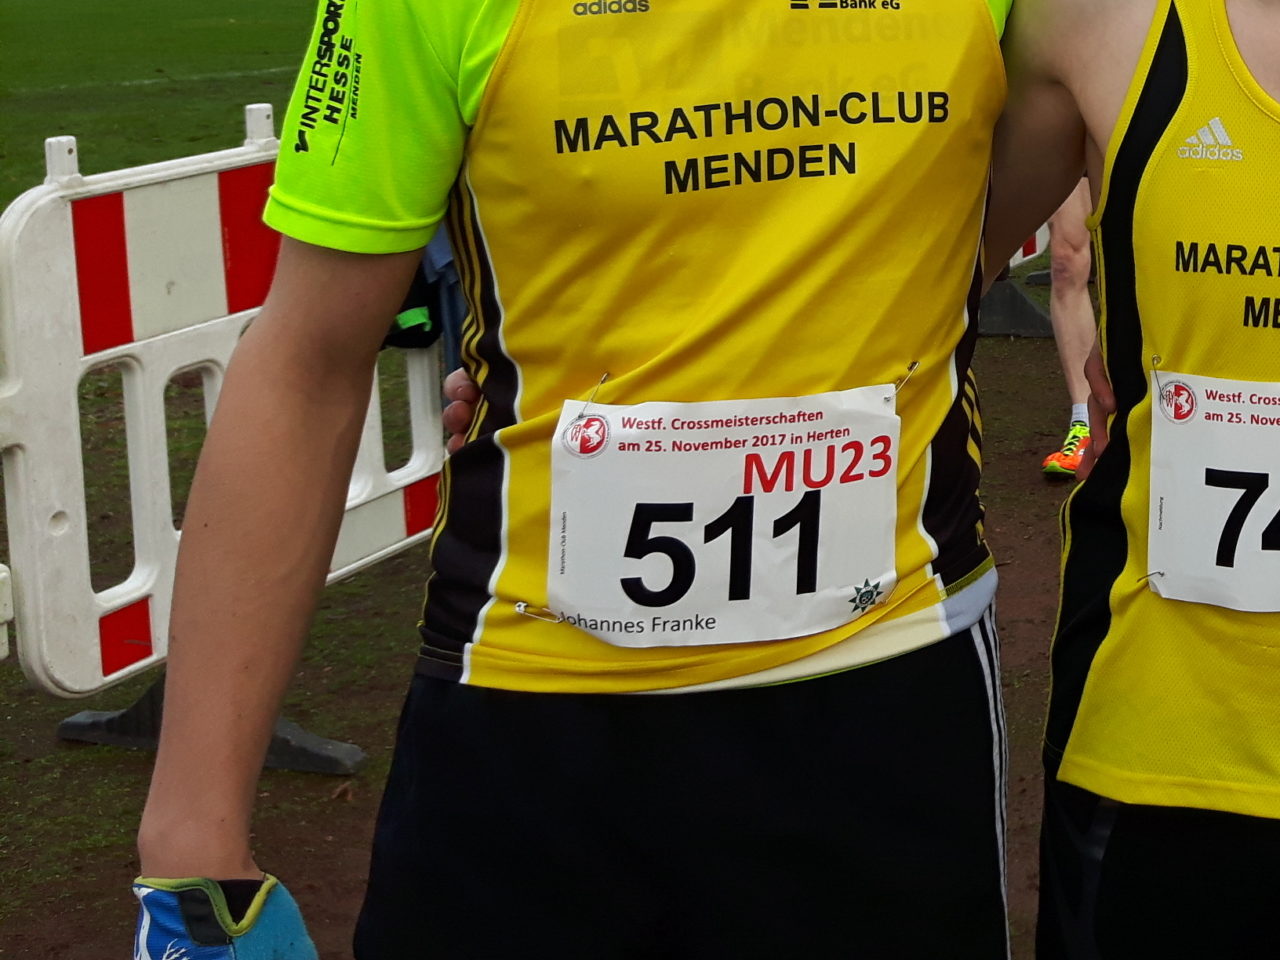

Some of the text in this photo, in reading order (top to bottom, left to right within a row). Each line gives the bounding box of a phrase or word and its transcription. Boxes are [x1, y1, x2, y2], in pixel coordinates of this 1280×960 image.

[323, 35, 353, 125] HESSE
[350, 53, 363, 120] MENDEN
[554, 91, 950, 154] MARATHON-CLUB
[664, 142, 857, 195] MENDEN
[1177, 144, 1244, 161] adidas
[1205, 389, 1245, 404] Westf.
[621, 409, 824, 431] Westf. Crossmeisterschaften
[1204, 411, 1224, 423] am
[1227, 412, 1247, 424] 25.
[618, 426, 851, 452] am 25. November 2017 in Herten
[743, 434, 893, 495] MU23
[620, 489, 822, 608] 511
[651, 613, 717, 632] Franke
